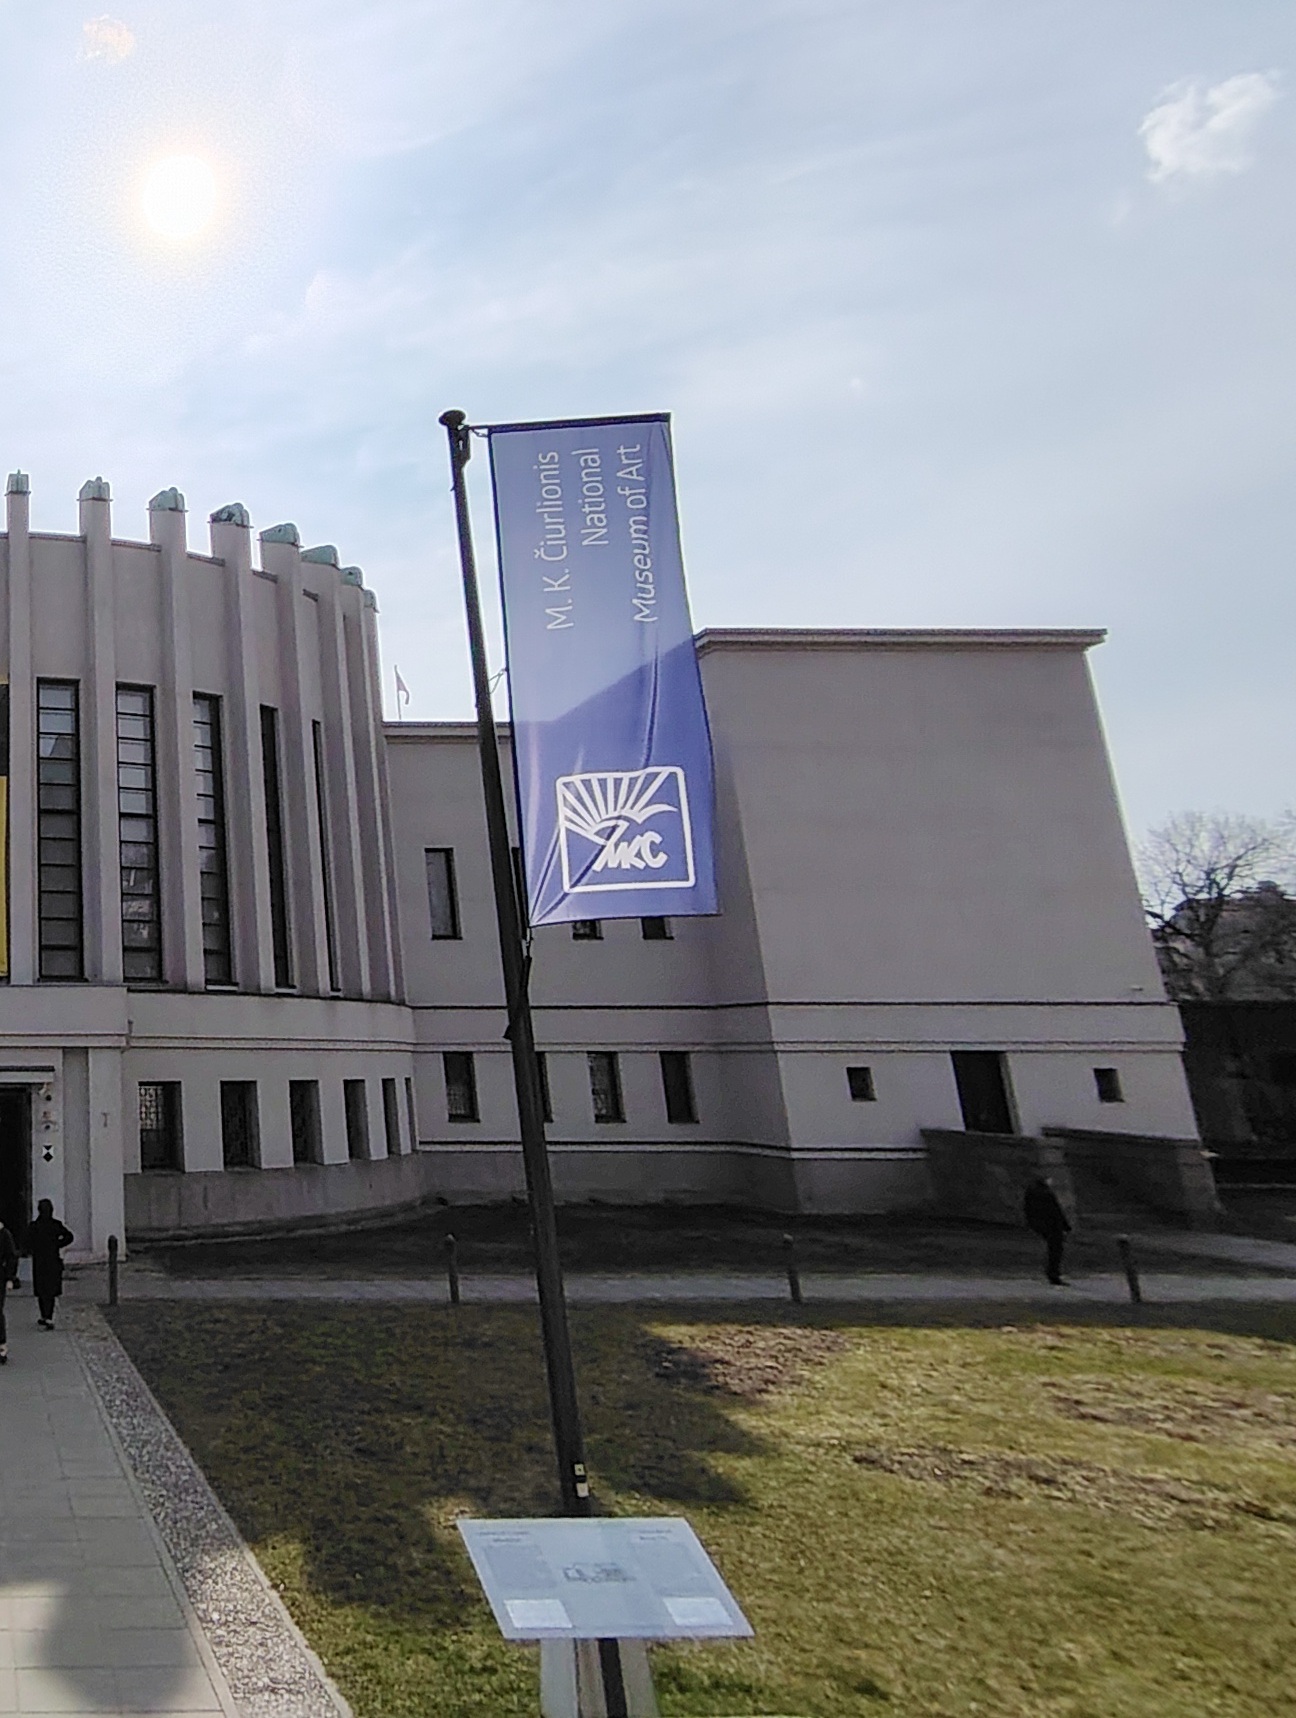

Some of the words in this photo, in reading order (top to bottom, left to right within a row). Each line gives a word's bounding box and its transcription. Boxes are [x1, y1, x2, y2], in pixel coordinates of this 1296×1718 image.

[615, 444, 645, 481] Art
[533, 451, 569, 562] Čiurlionis
[571, 448, 609, 546] National
[616, 486, 647, 509] of
[542, 568, 572, 592] K.
[628, 515, 659, 623] Museum
[544, 599, 575, 630] M.
